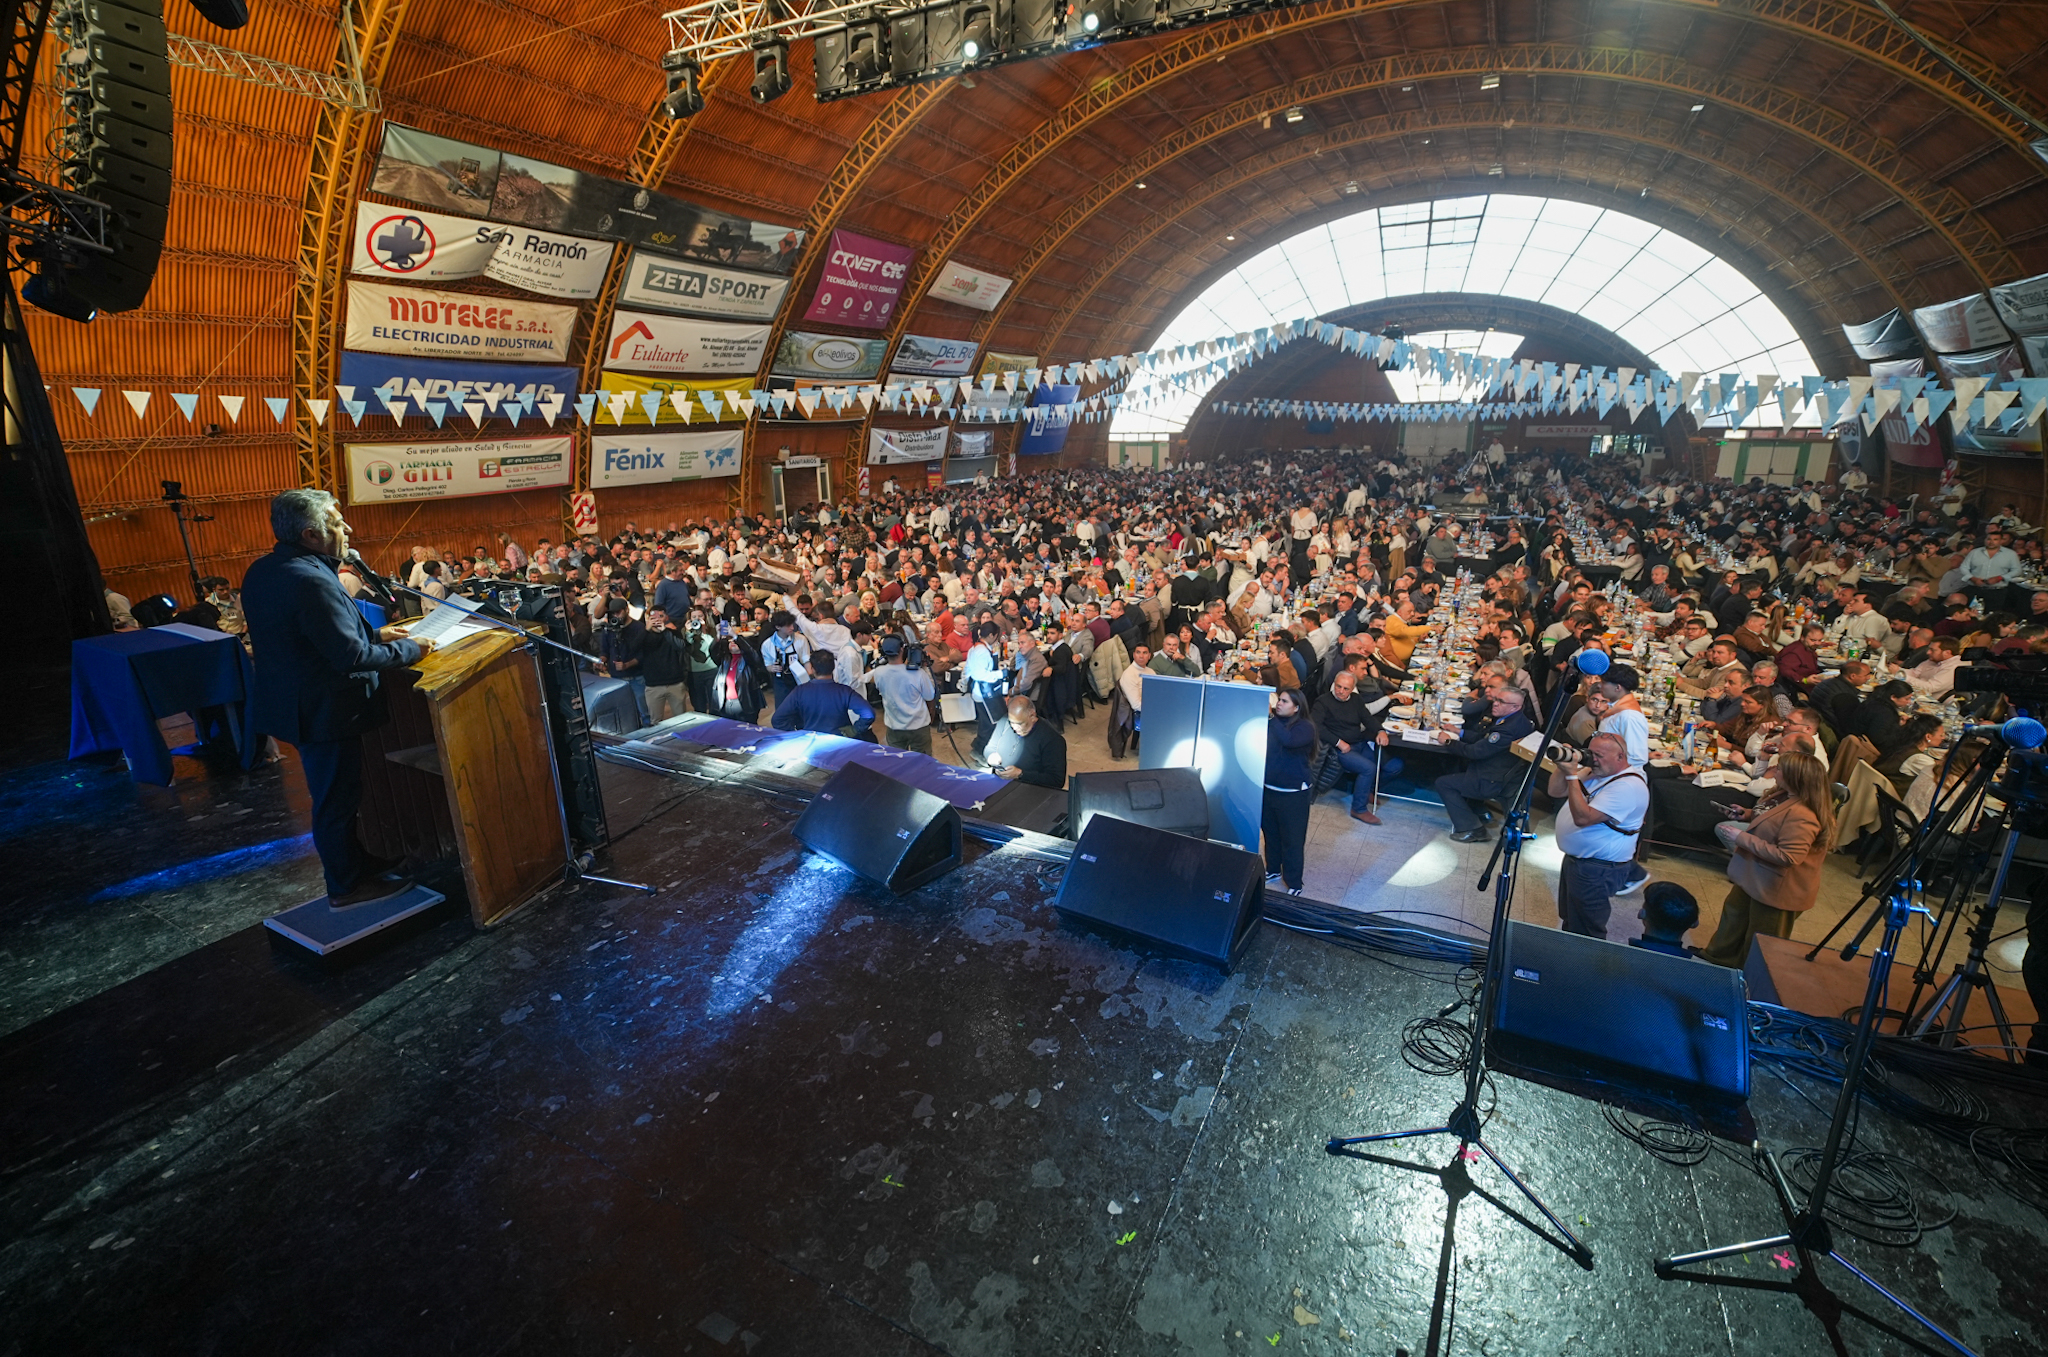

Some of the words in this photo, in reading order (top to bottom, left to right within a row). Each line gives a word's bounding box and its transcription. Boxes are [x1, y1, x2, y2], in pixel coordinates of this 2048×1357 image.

[476, 227, 514, 246] San
[524, 235, 587, 260] Ramón
[648, 270, 700, 294] ZETA
[708, 277, 770, 300] SPORT
[2020, 290, 2048, 306] ETROLE
[388, 296, 512, 330] MOTELEC
[372, 326, 480, 346] ELECTRICIDAD
[485, 336, 554, 349] INDUSTRIAL
[631, 344, 689, 364] Euliarte
[938, 345, 956, 358] DEL
[373, 377, 556, 402] ANDESMAR
[1840, 421, 1859, 437] PEPSI
[406, 447, 417, 455] Su
[420, 446, 439, 455] mejor
[506, 456, 558, 464] FARMACIA
[604, 447, 665, 471] Fénix
[788, 458, 816, 466] SANITARIOS
[404, 467, 452, 483] GILI
[504, 463, 560, 474] ESTRELLA
